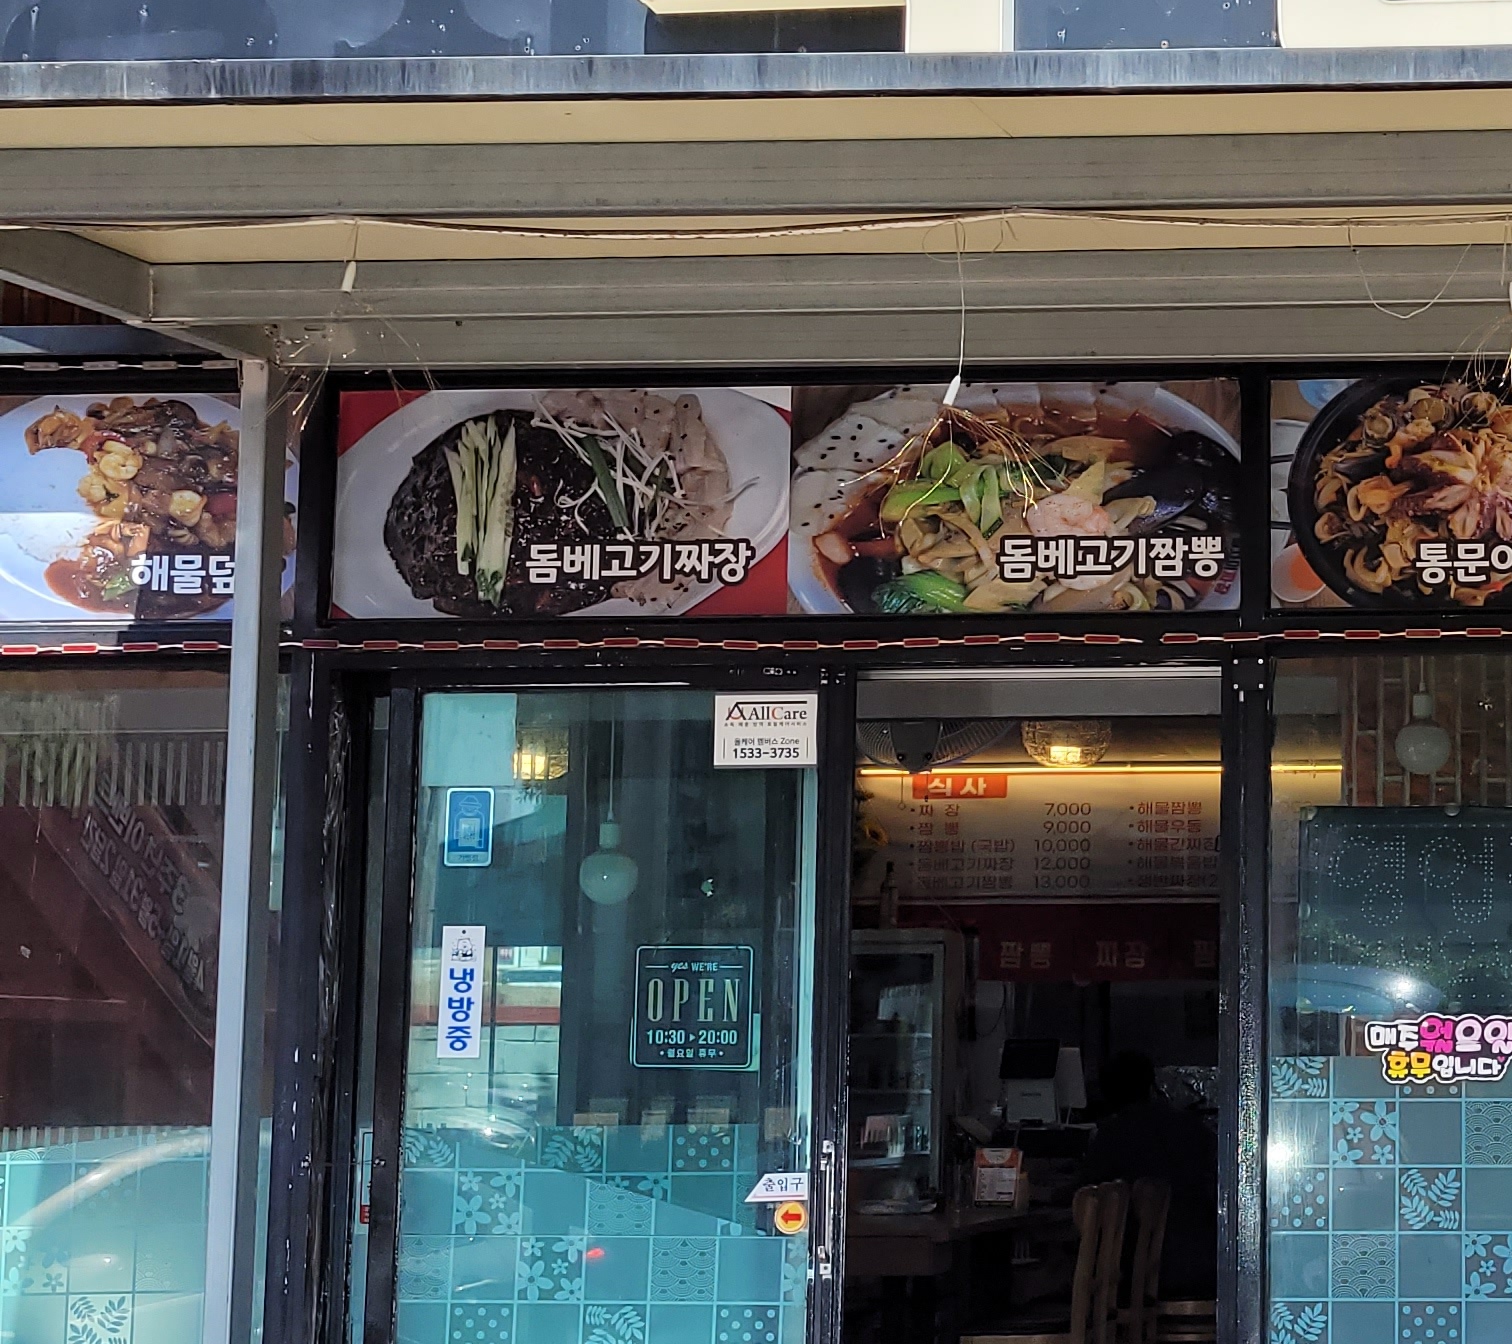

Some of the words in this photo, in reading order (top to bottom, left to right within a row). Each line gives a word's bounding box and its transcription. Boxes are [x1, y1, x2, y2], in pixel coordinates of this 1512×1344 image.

[525, 542, 752, 584] 돔베고기짜장
[1000, 536, 1225, 578] 돔베고기짬뽕
[747, 705, 808, 721] AllCare
[780, 737, 800, 745] Zone
[732, 747, 800, 759] 1533-3735
[1043, 802, 1092, 818] 7,000
[1042, 820, 1092, 836] 9,000
[1033, 838, 1092, 854] 10,000
[670, 961, 689, 973] yes
[691, 961, 718, 972] WE'RE
[647, 978, 740, 1022] OPEN
[444, 967, 475, 1052] 냉방중
[646, 1029, 686, 1045] 10:30
[698, 1029, 738, 1045] 20:00
[762, 1177, 805, 1192] 출입구
